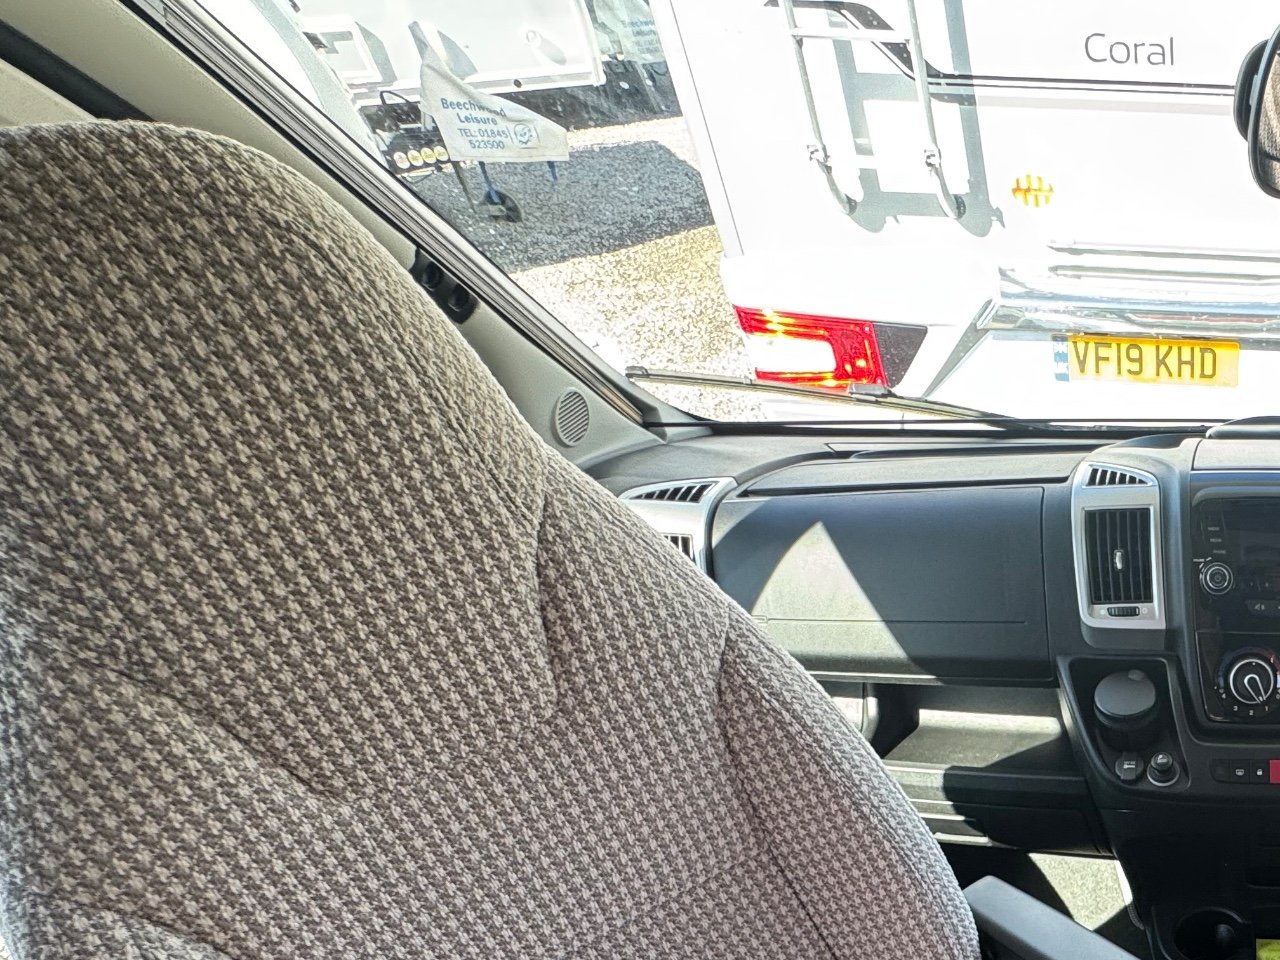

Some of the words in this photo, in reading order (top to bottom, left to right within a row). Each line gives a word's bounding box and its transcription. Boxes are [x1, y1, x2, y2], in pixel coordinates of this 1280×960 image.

[1084, 32, 1174, 66] Coral
[457, 112, 498, 126] Leisure
[468, 140, 506, 151] 523500
[1072, 340, 1144, 376] VF19
[1155, 344, 1218, 380] KHD
